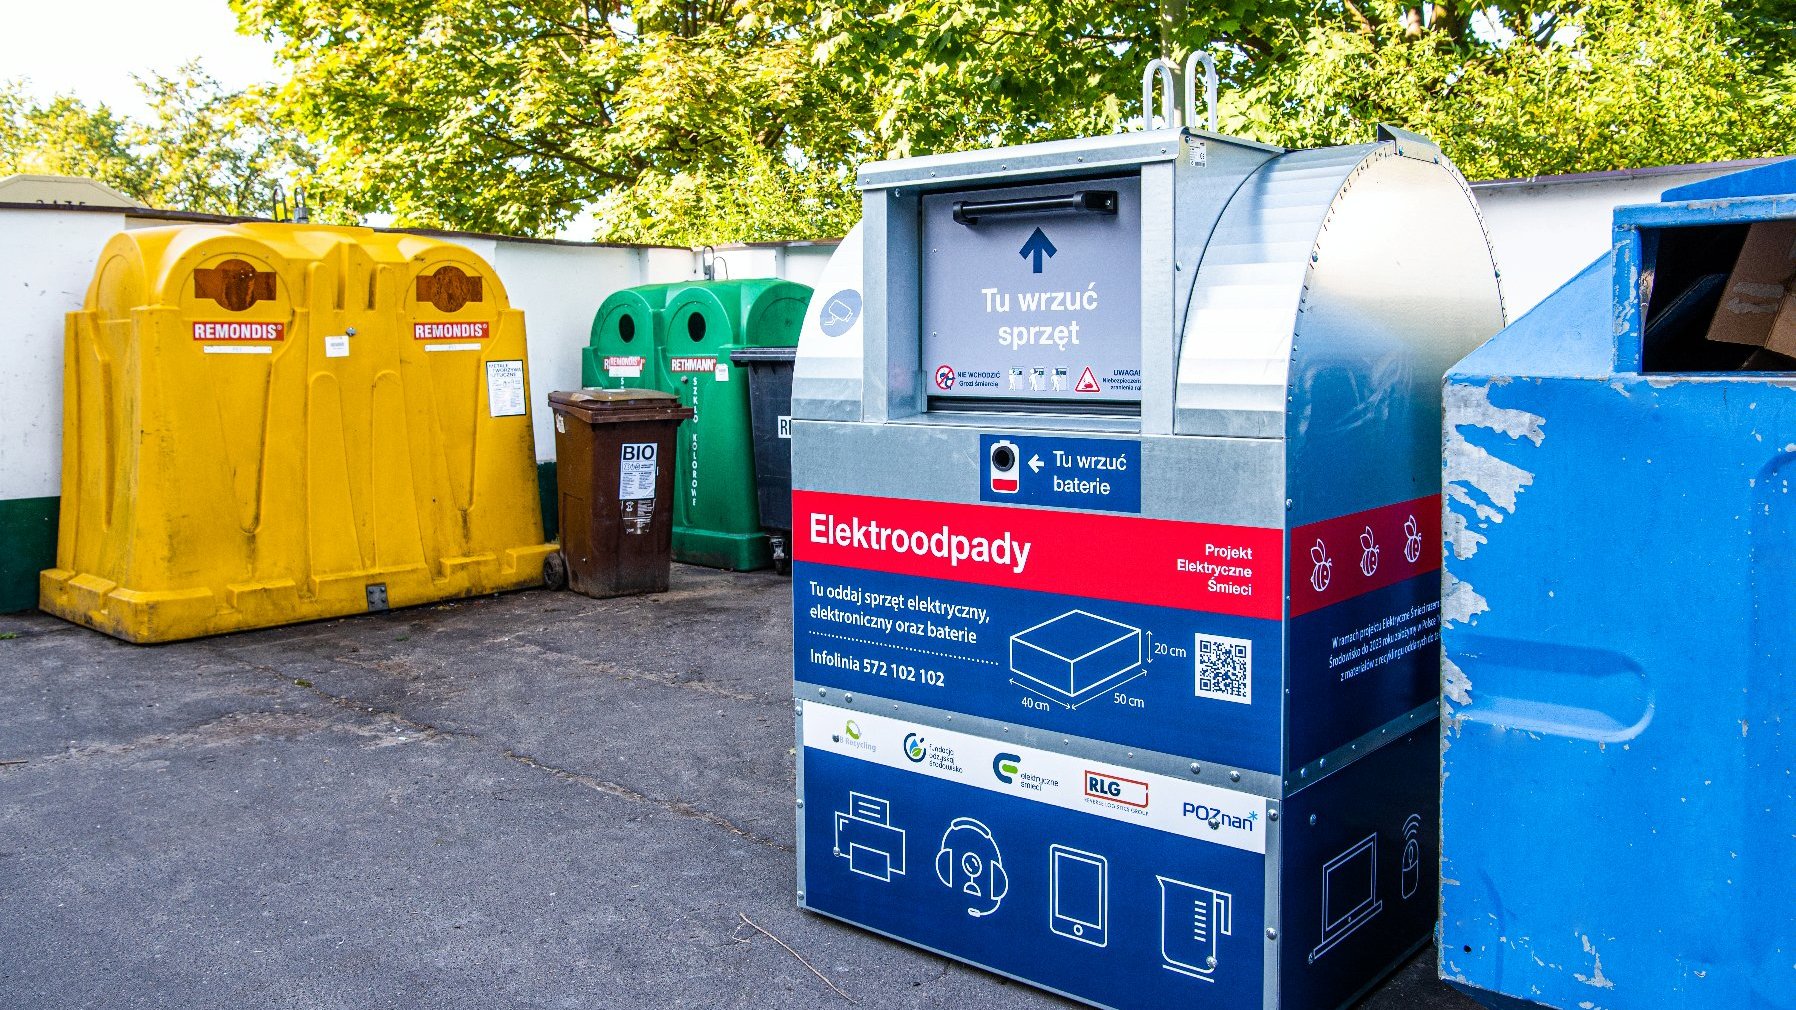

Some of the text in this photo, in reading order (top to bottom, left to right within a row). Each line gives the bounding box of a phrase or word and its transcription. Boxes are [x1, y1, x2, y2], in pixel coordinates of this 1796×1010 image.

[981, 281, 1098, 313] Tu wrzuć
[998, 321, 1080, 351] sprzęt
[623, 445, 655, 461] BIO
[1053, 450, 1127, 471] Tu wrzuć
[1053, 475, 1111, 495] baterie
[810, 512, 1032, 574] Elektroodpady
[1205, 543, 1253, 560] Projekt
[1177, 558, 1253, 578] Elektryczne
[1207, 578, 1253, 596] Śmieci
[810, 580, 990, 624] Tu oddaj sprzęt elektryczny,
[810, 604, 977, 644] elektroniczny oraz baterie
[1154, 642, 1187, 658] 20 cm
[810, 648, 945, 687] Infolinia 572 102 102
[1021, 697, 1050, 711] 40 cm
[1113, 692, 1145, 708] 50 cm
[845, 737, 877, 752] Recycling
[1089, 776, 1121, 797] RLG
